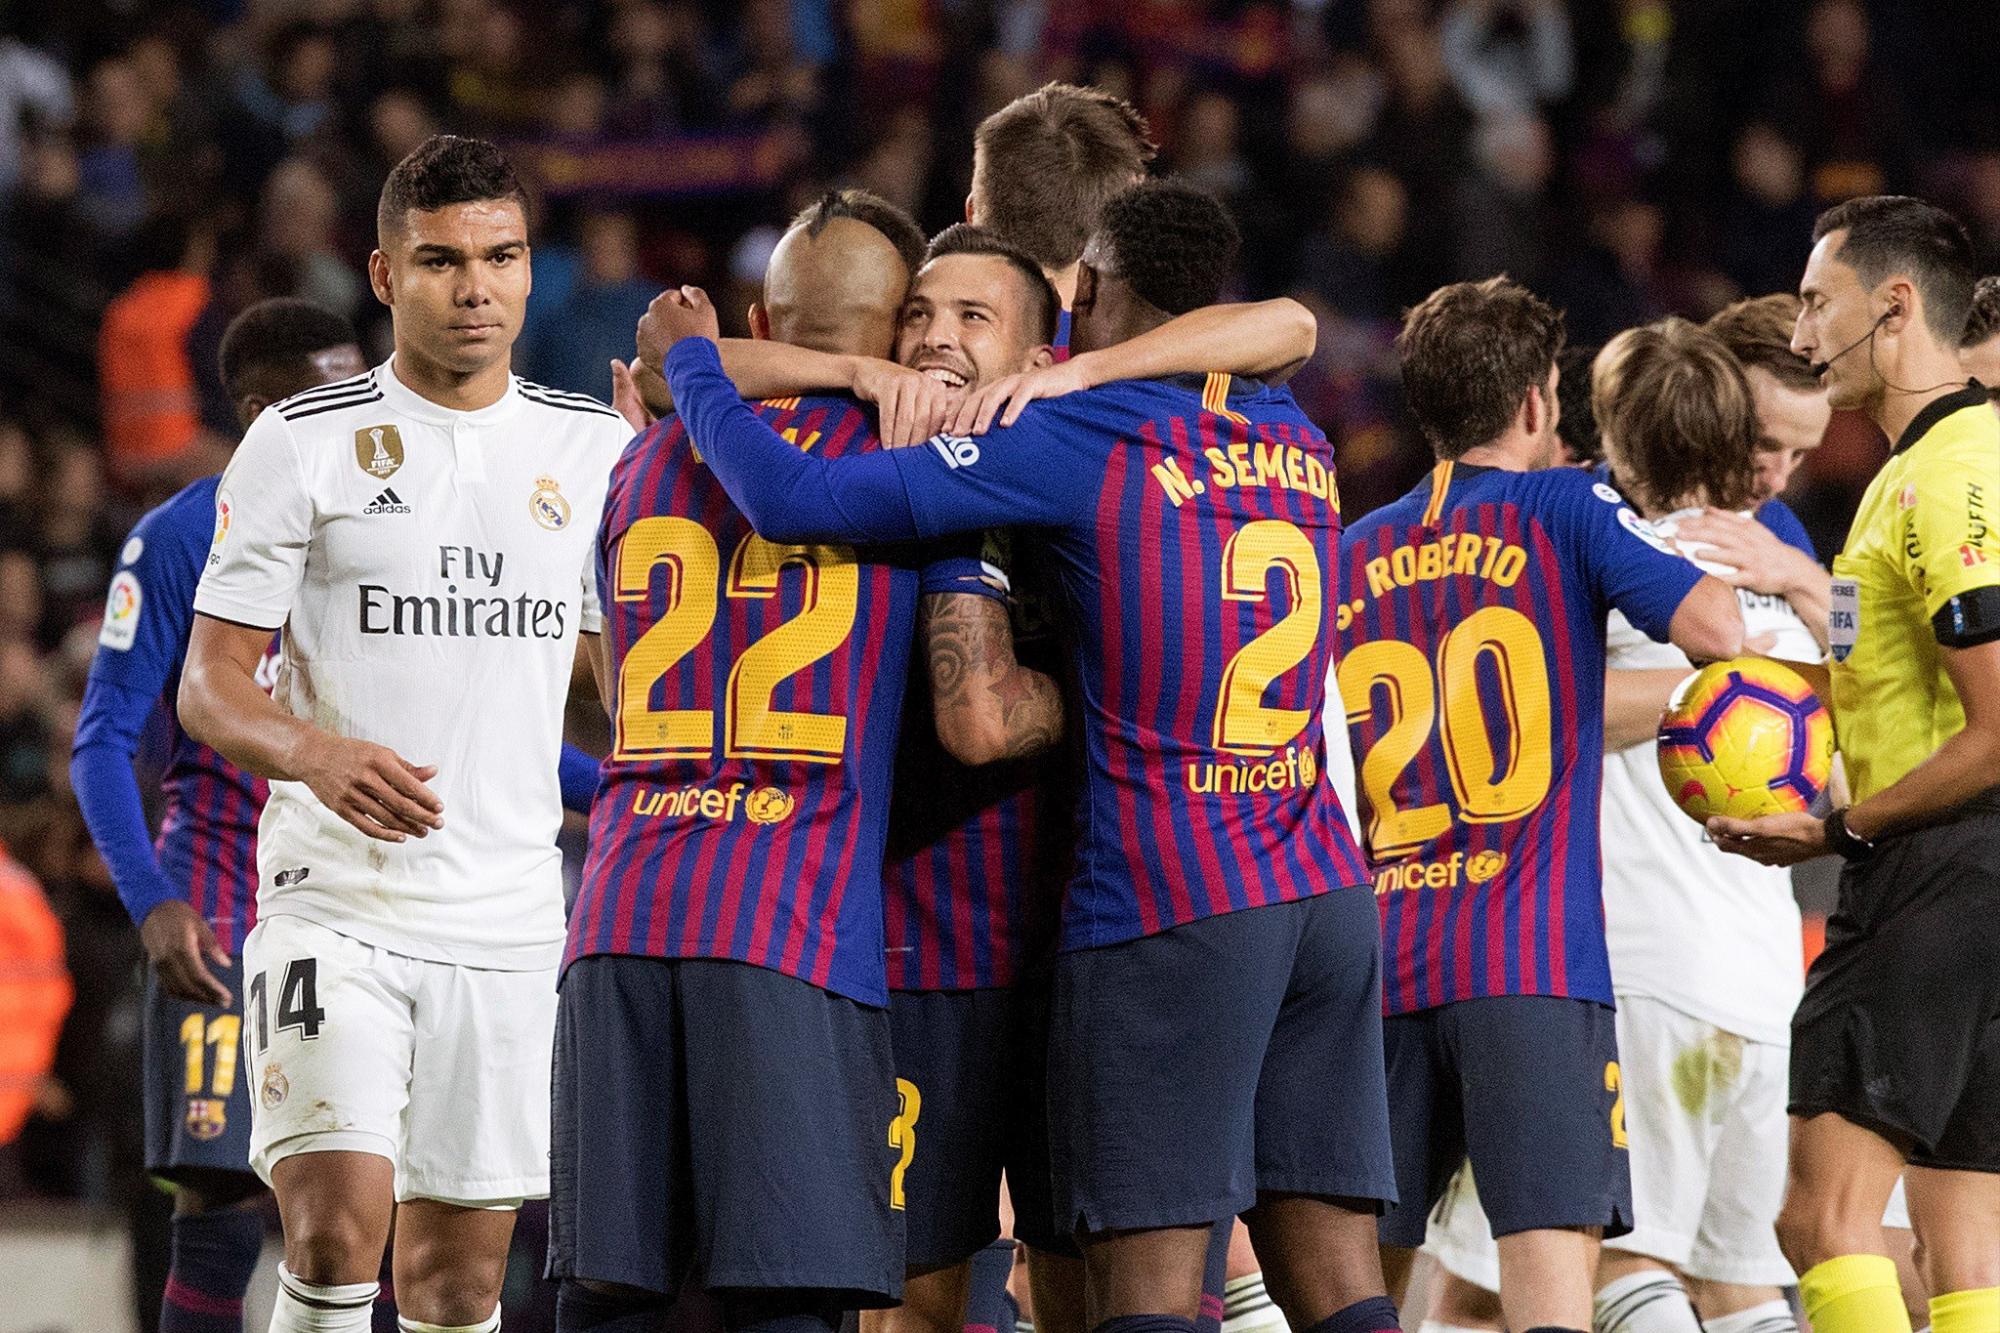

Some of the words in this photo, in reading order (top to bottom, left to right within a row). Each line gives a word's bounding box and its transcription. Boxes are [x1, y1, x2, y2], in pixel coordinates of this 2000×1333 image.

[363, 503, 411, 515] adidas
[1151, 456, 1205, 507] N.
[439, 545, 504, 587] Fly
[1365, 533, 1527, 598] ROBERTO
[358, 584, 567, 640] Emirates
[613, 516, 859, 765] 22
[1212, 519, 1322, 757] 2
[1336, 606, 1551, 859] 20
[1188, 747, 1298, 793] unicef
[632, 783, 745, 822] unicef
[250, 957, 325, 1056] 14
[180, 1012, 241, 1096] 11
